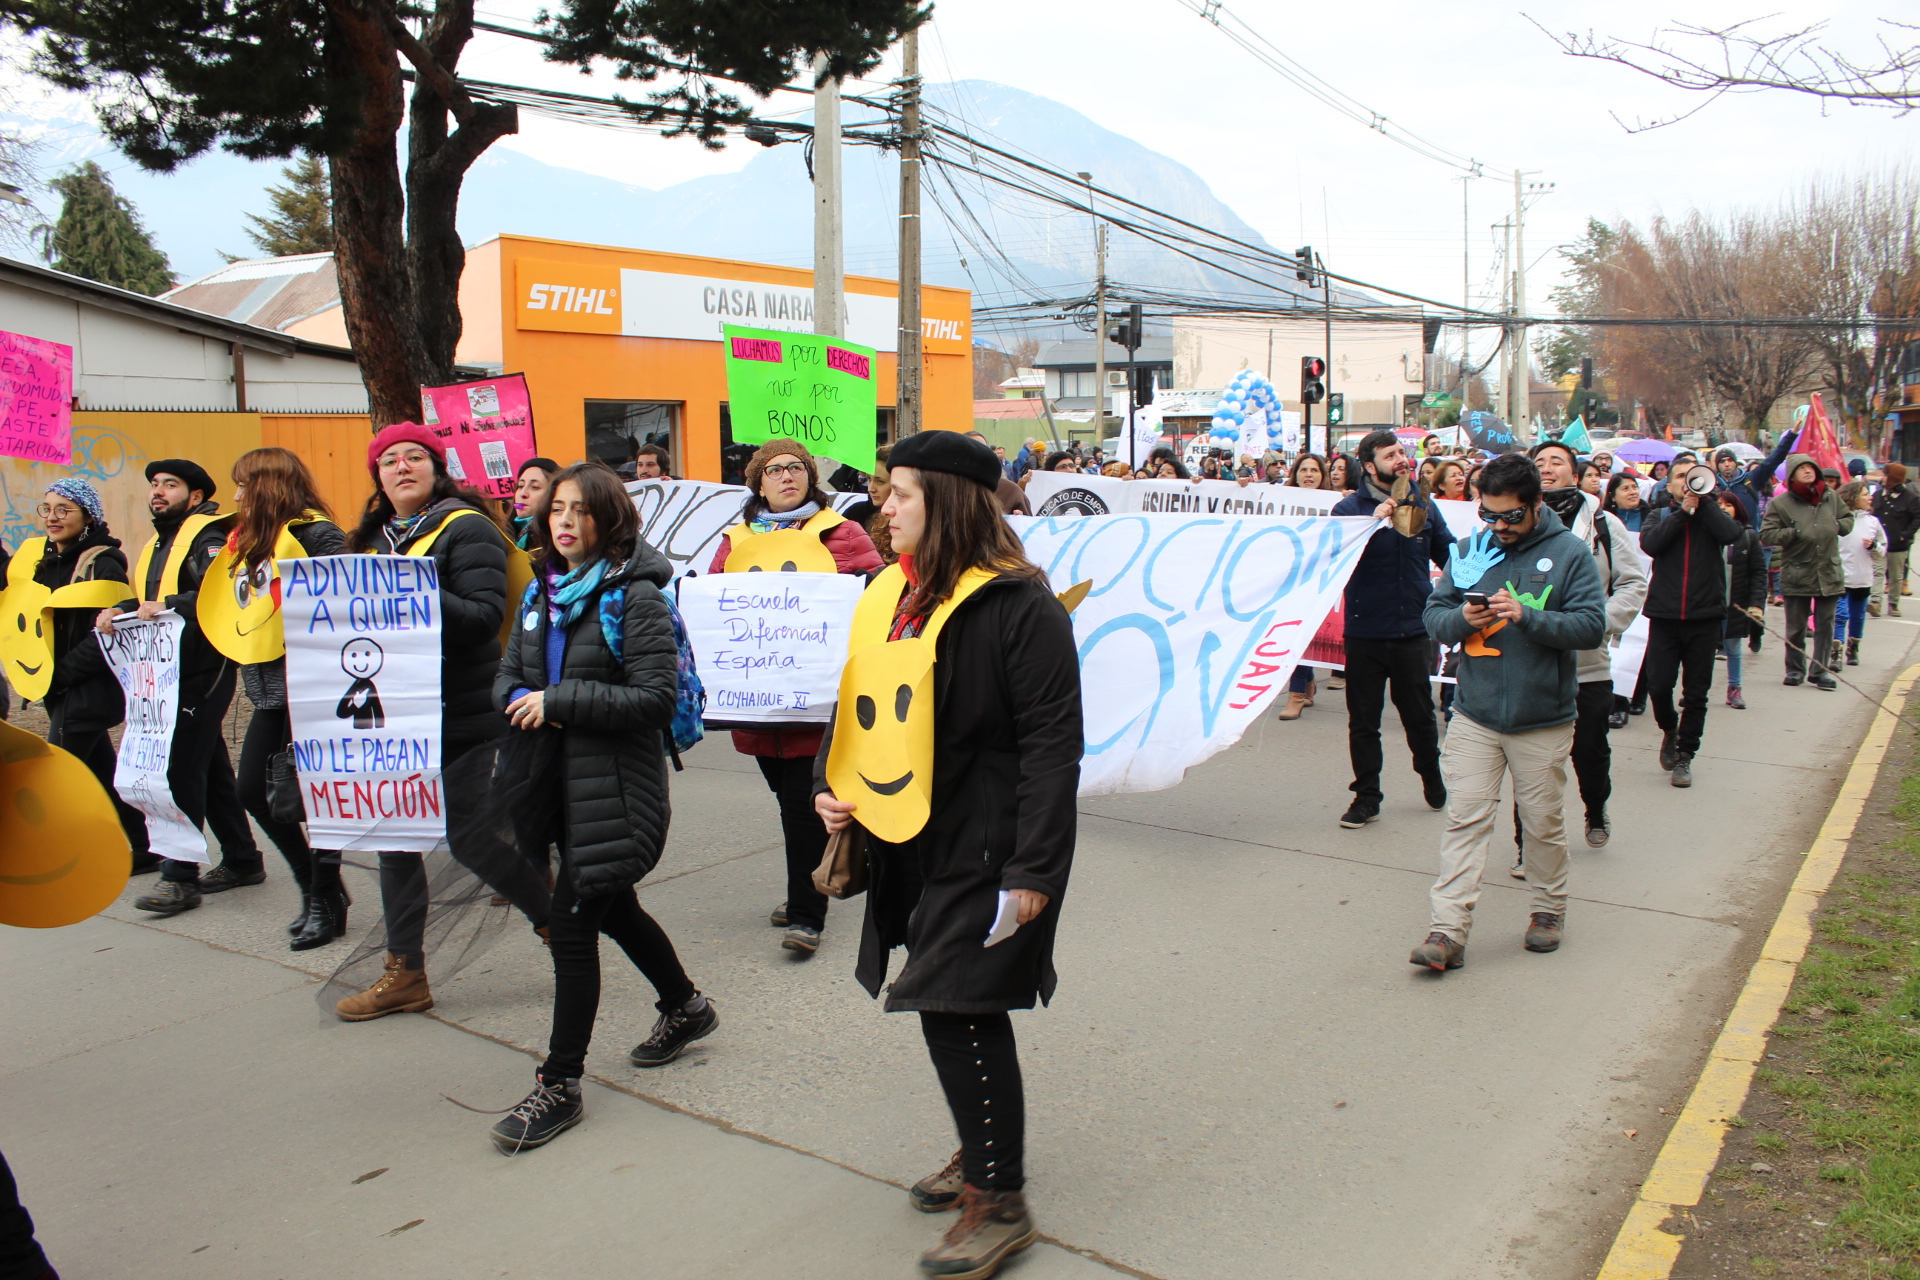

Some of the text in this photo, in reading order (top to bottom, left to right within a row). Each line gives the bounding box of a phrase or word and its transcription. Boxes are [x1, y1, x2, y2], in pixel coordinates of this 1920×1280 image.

[526, 283, 613, 315] STIHL
[703, 285, 758, 318] CASA
[731, 337, 870, 378] LUCHAMOS por DERECHOS
[0, 378, 72, 407] RDOMUDA,
[766, 378, 844, 411] no por
[768, 410, 837, 443] BONOS
[1071, 490, 1085, 501] DE
[1462, 568, 1470, 576] LA
[1471, 553, 1485, 564] NO
[286, 557, 438, 599] ADIVINEN
[308, 592, 432, 635] A QUIÉN
[717, 586, 810, 614] Escuela
[99, 621, 174, 667] PROFESORES
[723, 616, 828, 650] Diferencial
[792, 690, 811, 711] XI
[293, 737, 429, 773] NO LE PAGAN
[310, 772, 440, 820] MENCIÓN
